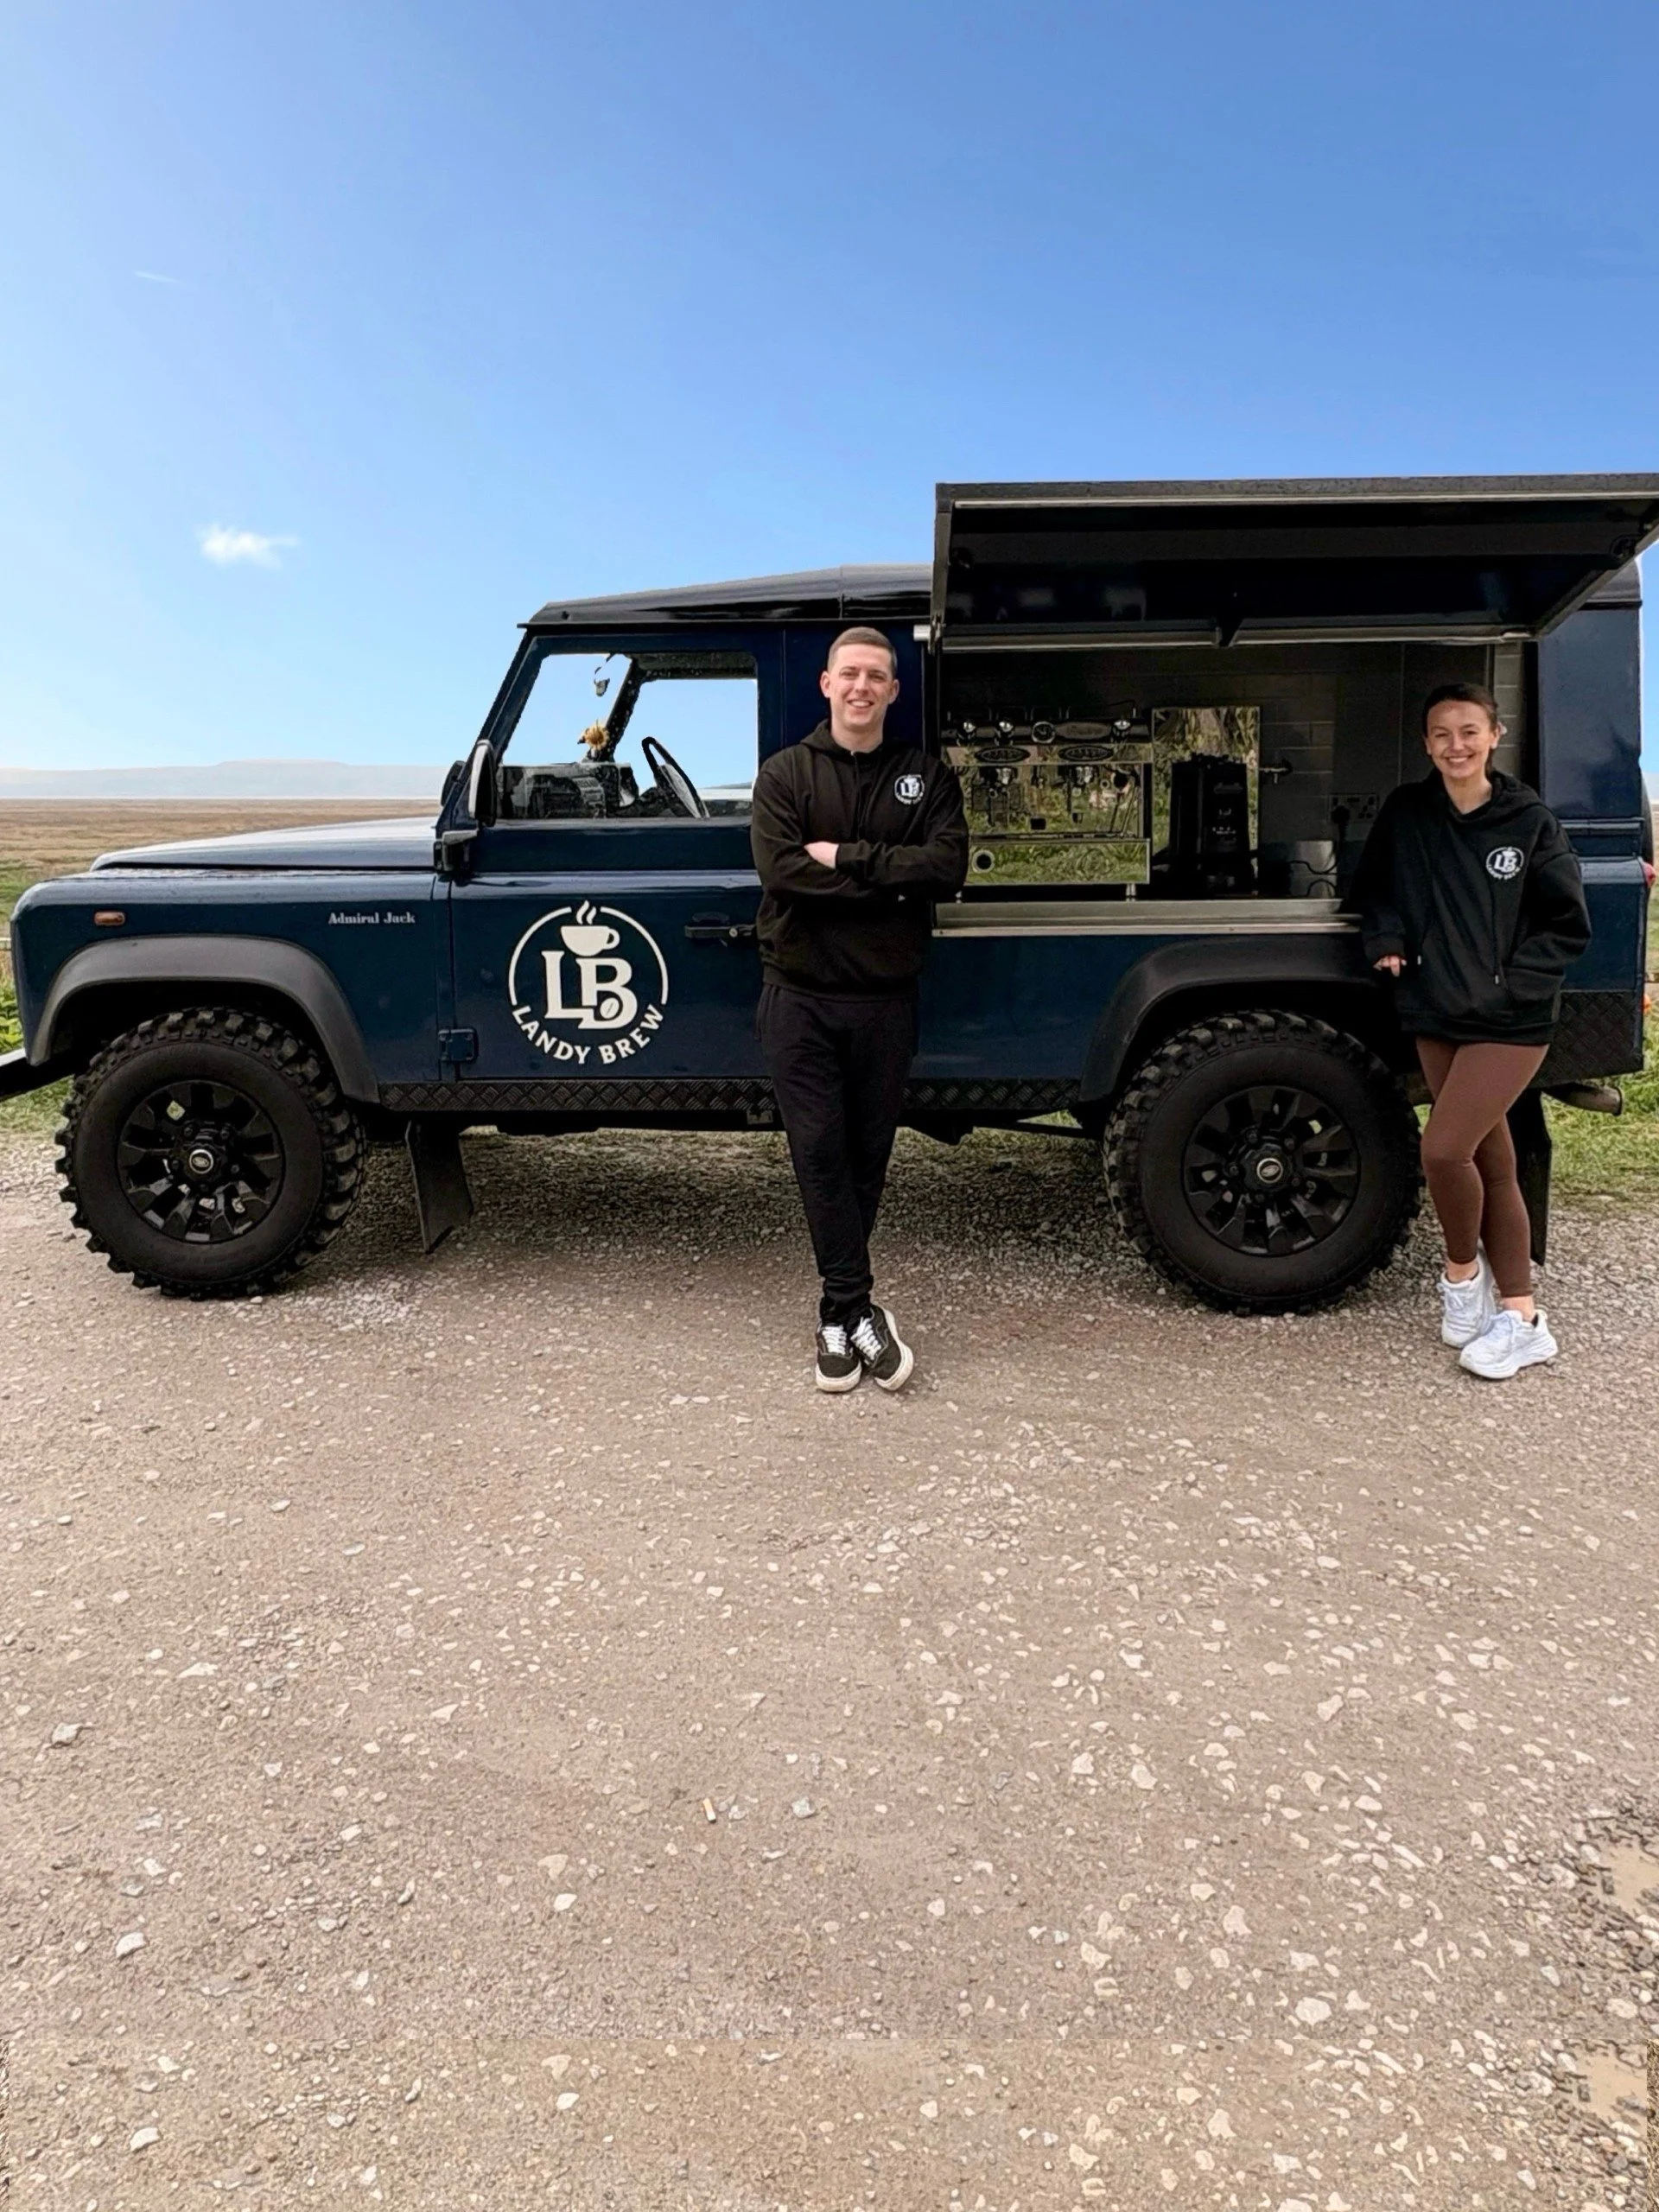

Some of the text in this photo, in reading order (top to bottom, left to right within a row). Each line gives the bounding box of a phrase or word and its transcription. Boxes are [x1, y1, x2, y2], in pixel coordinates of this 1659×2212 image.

[1494, 854, 1517, 873] LB
[328, 912, 416, 924] Admiral Jack
[541, 950, 638, 1029] LB
[512, 1004, 664, 1065] LANDY BREW
